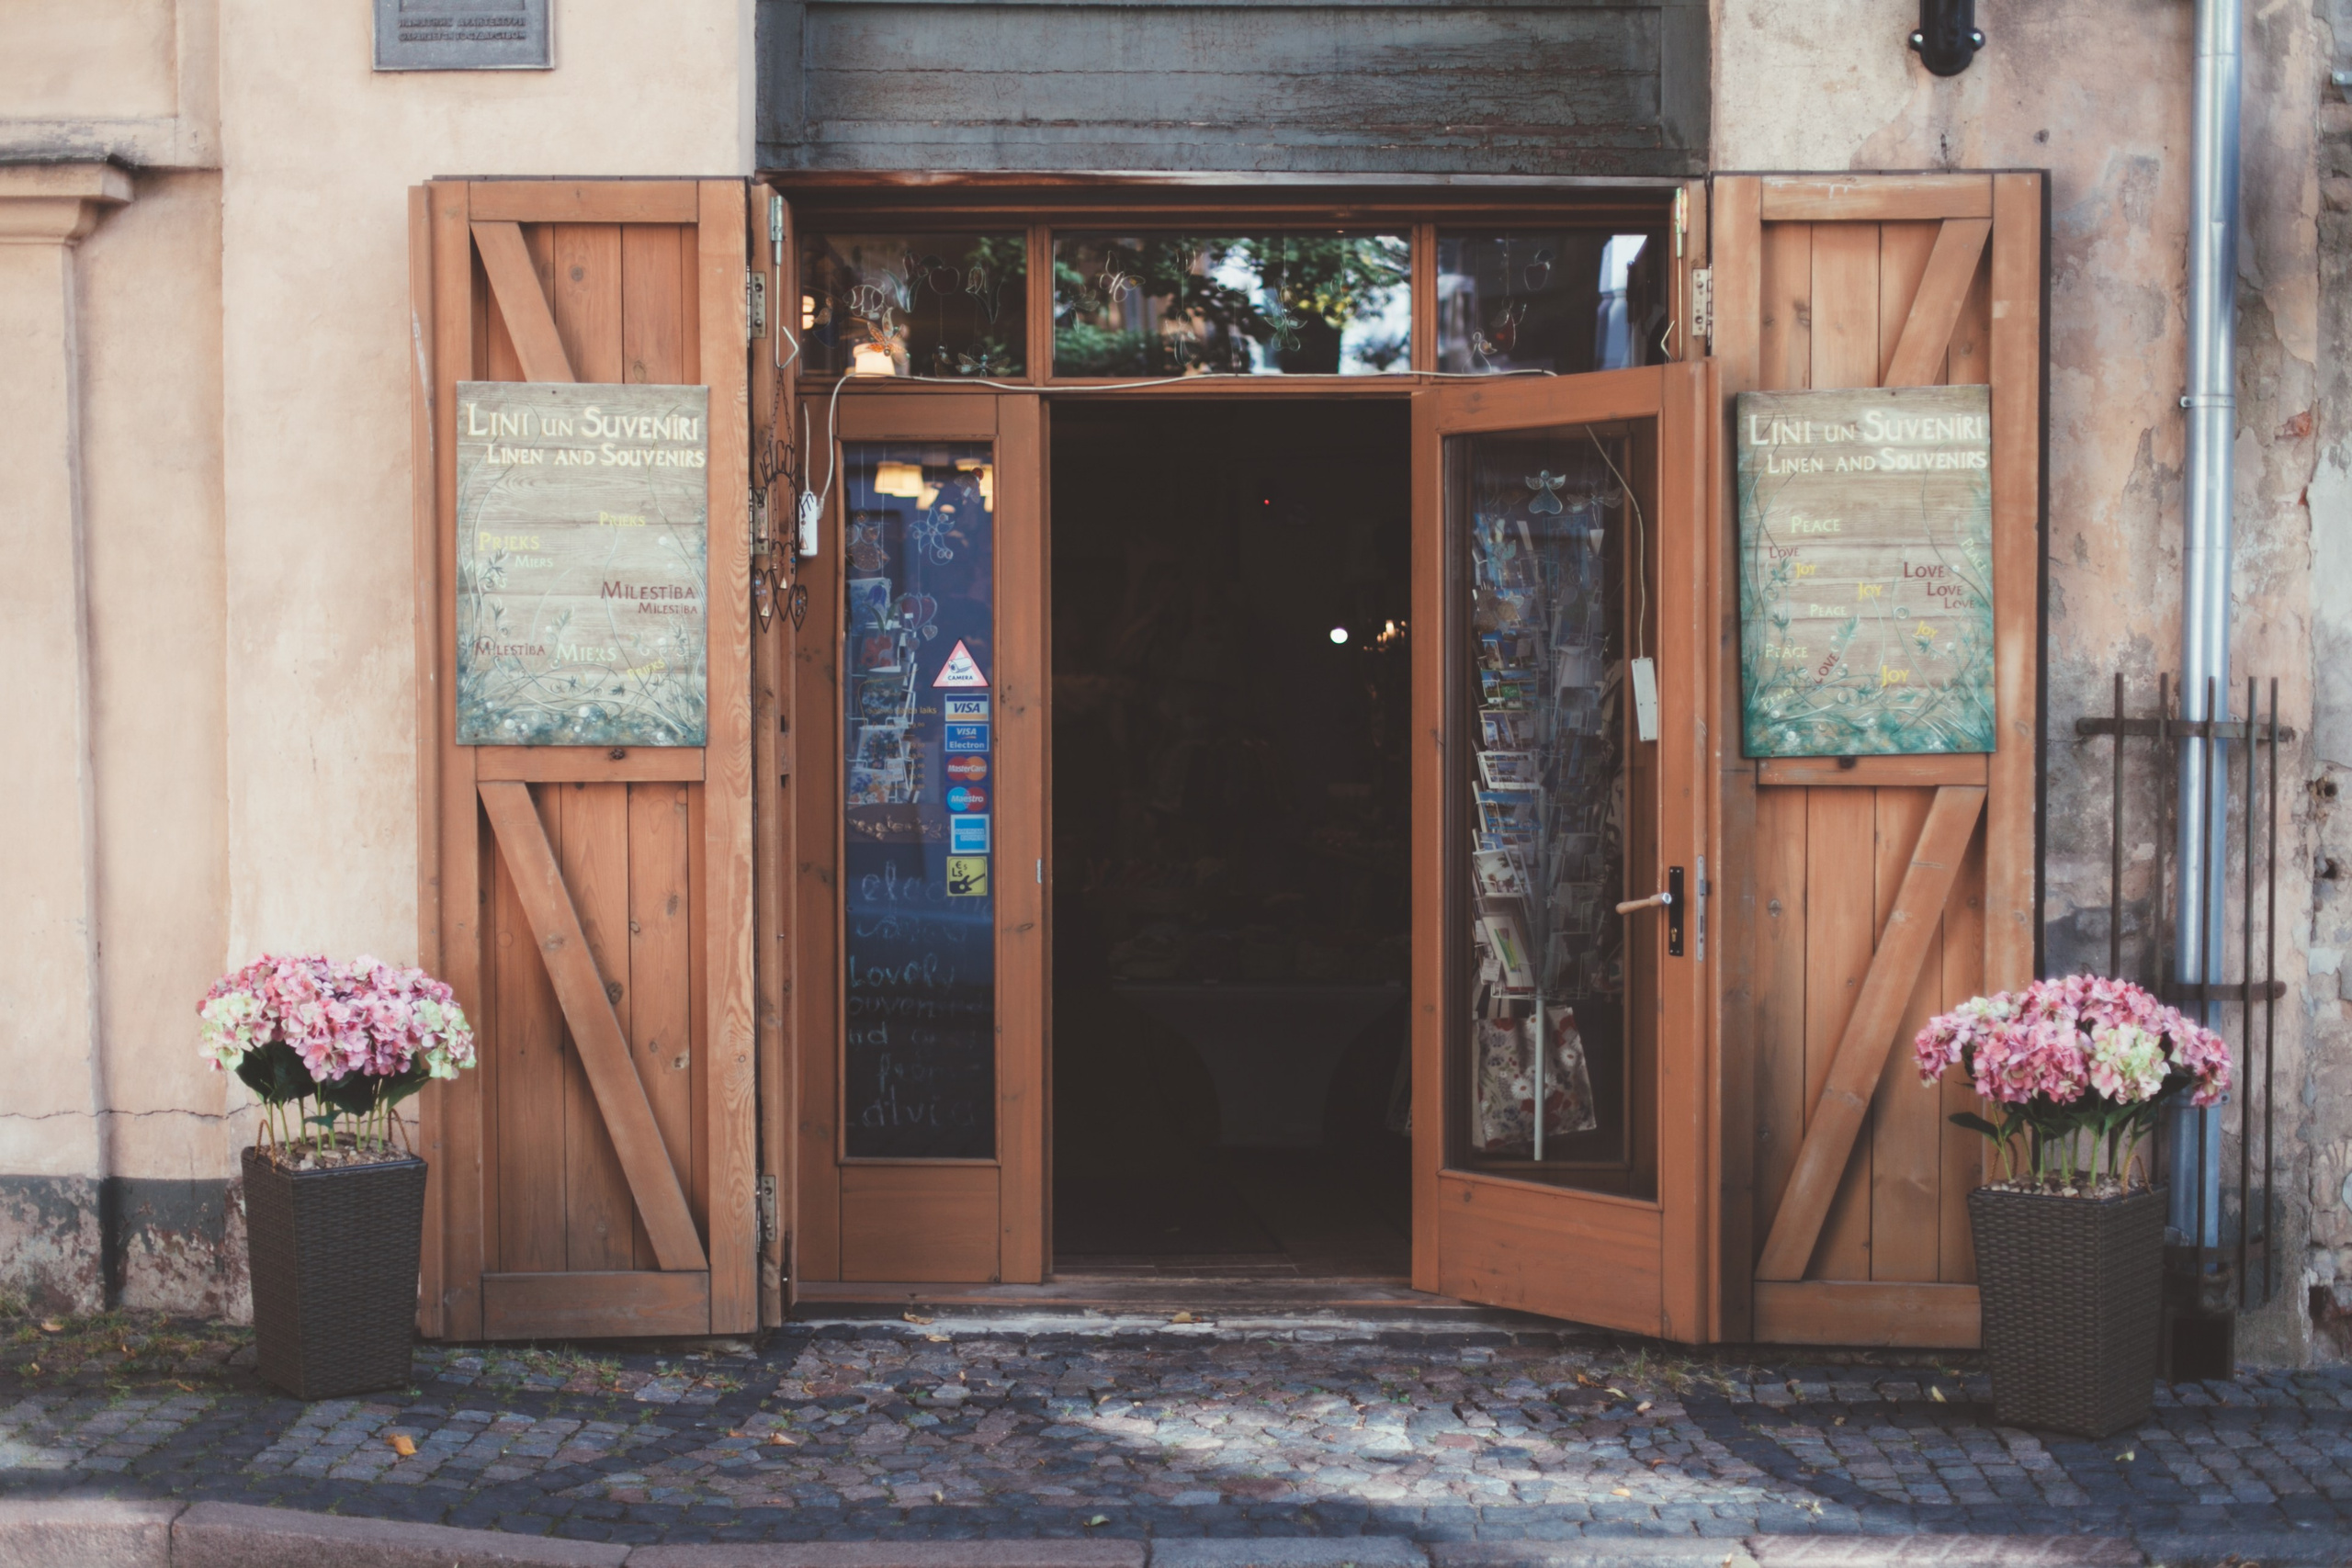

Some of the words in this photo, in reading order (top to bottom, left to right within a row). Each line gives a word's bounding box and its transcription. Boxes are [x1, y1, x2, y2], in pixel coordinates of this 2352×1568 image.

[467, 402, 528, 436] LINI
[541, 418, 573, 436] UN
[1748, 413, 1812, 446] LINI
[1824, 424, 1855, 442] UN
[487, 444, 544, 466] LINEN
[555, 448, 595, 466] AND
[600, 442, 706, 468] SOUVENIRS
[1767, 454, 1824, 475] LINEN
[1836, 456, 1876, 471] AND
[1880, 446, 1988, 471] SOUVENIRS
[1791, 516, 1841, 534] PEACE
[479, 531, 540, 551] PRIEKS
[514, 554, 554, 569] MIERS
[1770, 547, 1801, 559] LOVE
[1795, 562, 1817, 578] JOY
[1904, 561, 1945, 579] LOVE
[1858, 582, 1883, 601] JOY
[1927, 581, 1963, 596] LOVE
[1810, 604, 1848, 617] PEACE
[1944, 597, 1975, 609] LOVE
[1915, 620, 1939, 639] JOY
[556, 643, 617, 662] MIERS
[1765, 644, 1808, 659] PEACE
[1814, 653, 1840, 685] LOVE
[1881, 665, 1910, 687] JOY
[954, 703, 980, 713] VISA
[947, 764, 987, 773] MasterCard
[951, 795, 984, 803] Maestro
